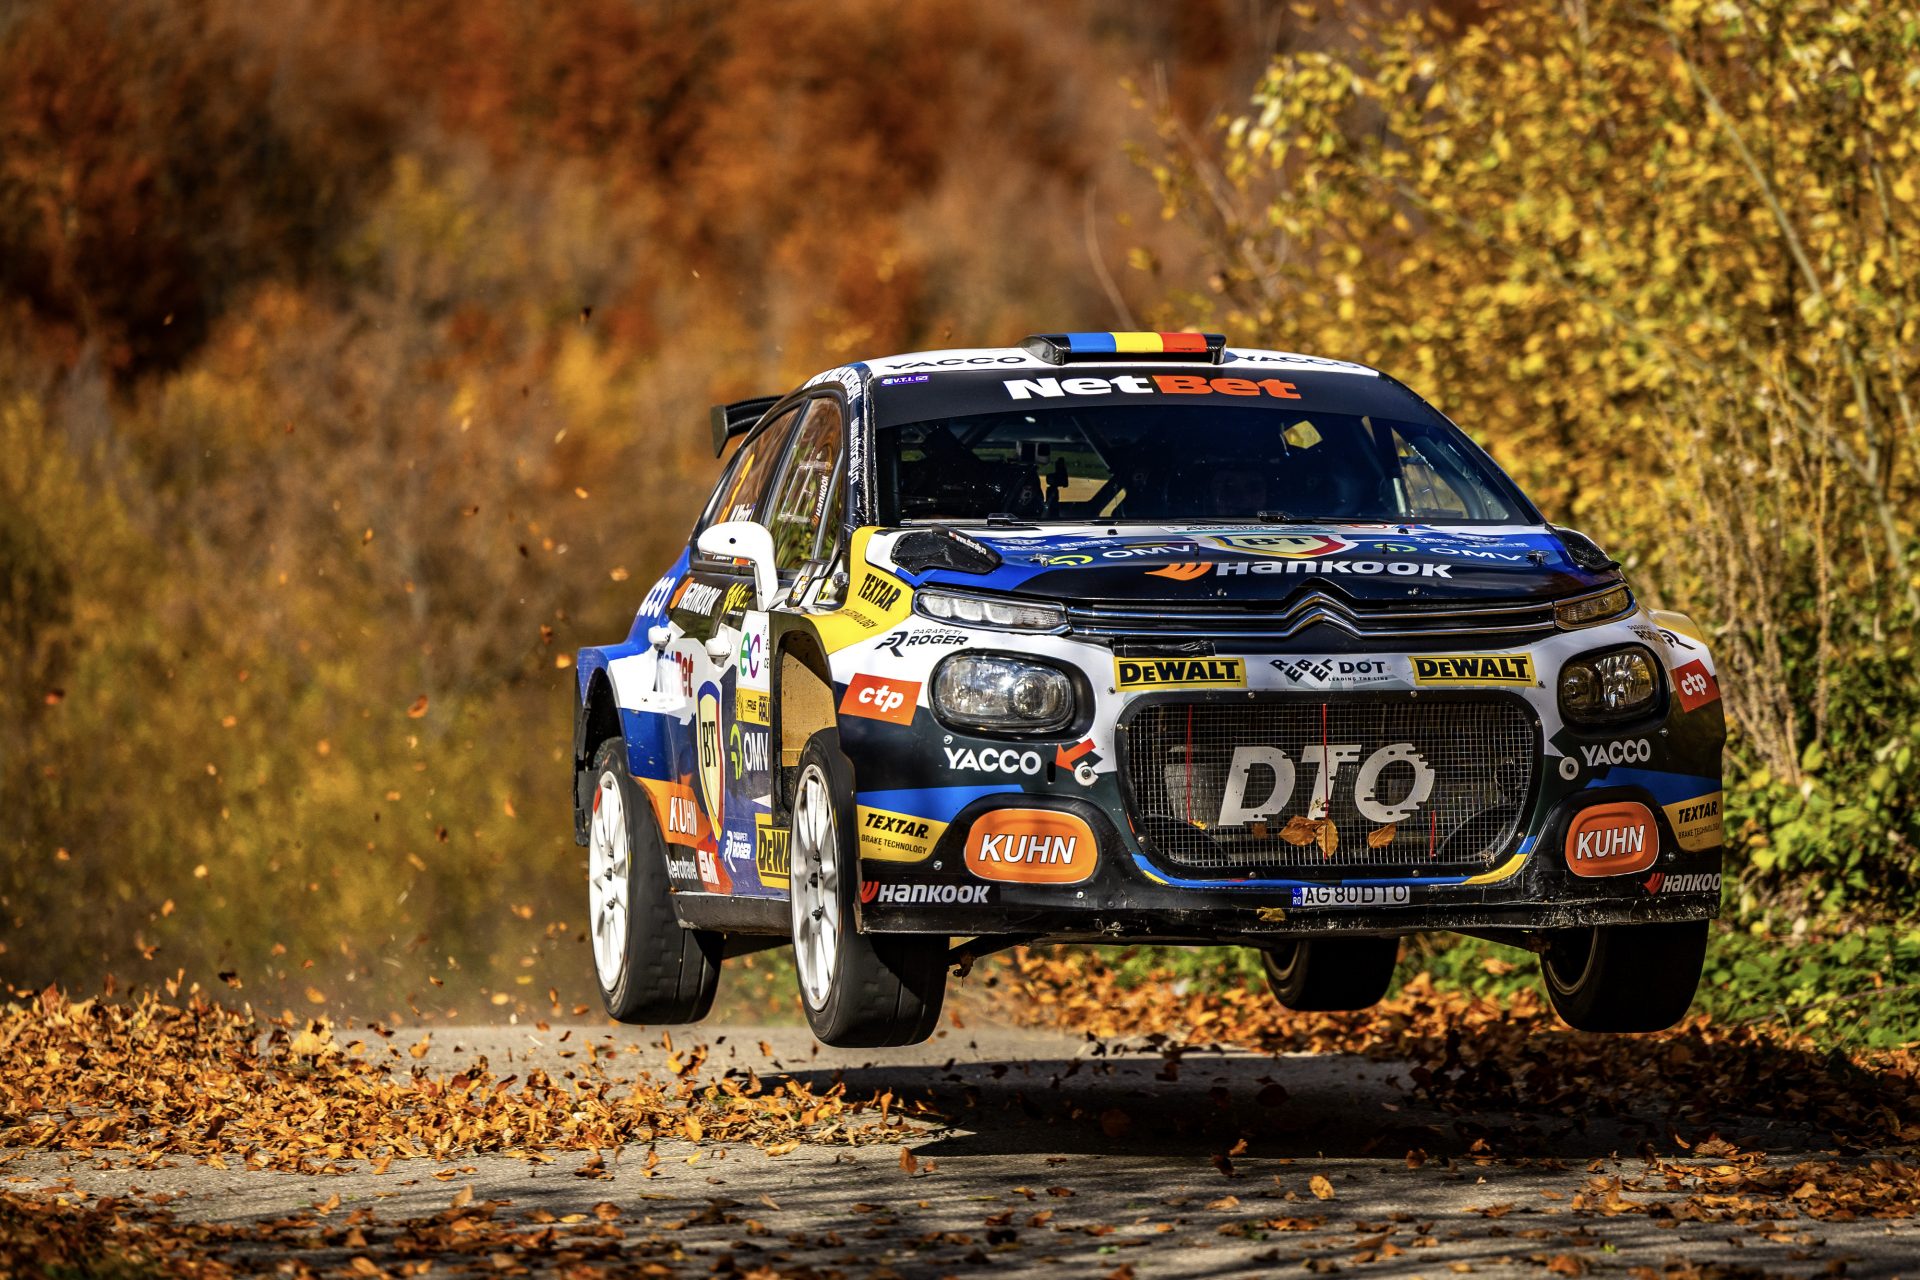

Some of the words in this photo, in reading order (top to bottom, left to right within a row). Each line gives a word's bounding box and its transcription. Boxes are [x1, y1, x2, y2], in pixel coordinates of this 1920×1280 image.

[885, 356, 1027, 370] YACCO
[1003, 375, 1302, 400] NetBet
[1102, 545, 1190, 559] OMV
[1429, 547, 1522, 561] OMV
[857, 572, 902, 612] TEXTAR
[906, 635, 969, 647] ROGER
[1338, 661, 1386, 674] DOT
[1681, 672, 1707, 696] ctp
[858, 685, 904, 713] ctp
[702, 720, 717, 768] BT
[743, 732, 769, 771] OMV
[1580, 738, 1651, 767] YACCO
[943, 747, 1042, 775] YACCO
[1218, 742, 1436, 827] DTO
[669, 796, 698, 837] KUHN
[861, 834, 883, 846] BRAKE
[883, 837, 928, 855] TECHNOLOGY
[1576, 824, 1645, 861] KUHN
[1678, 828, 1694, 840] BRAKE
[978, 833, 1078, 865] KUHN
[1661, 872, 1722, 893] Hankoo
